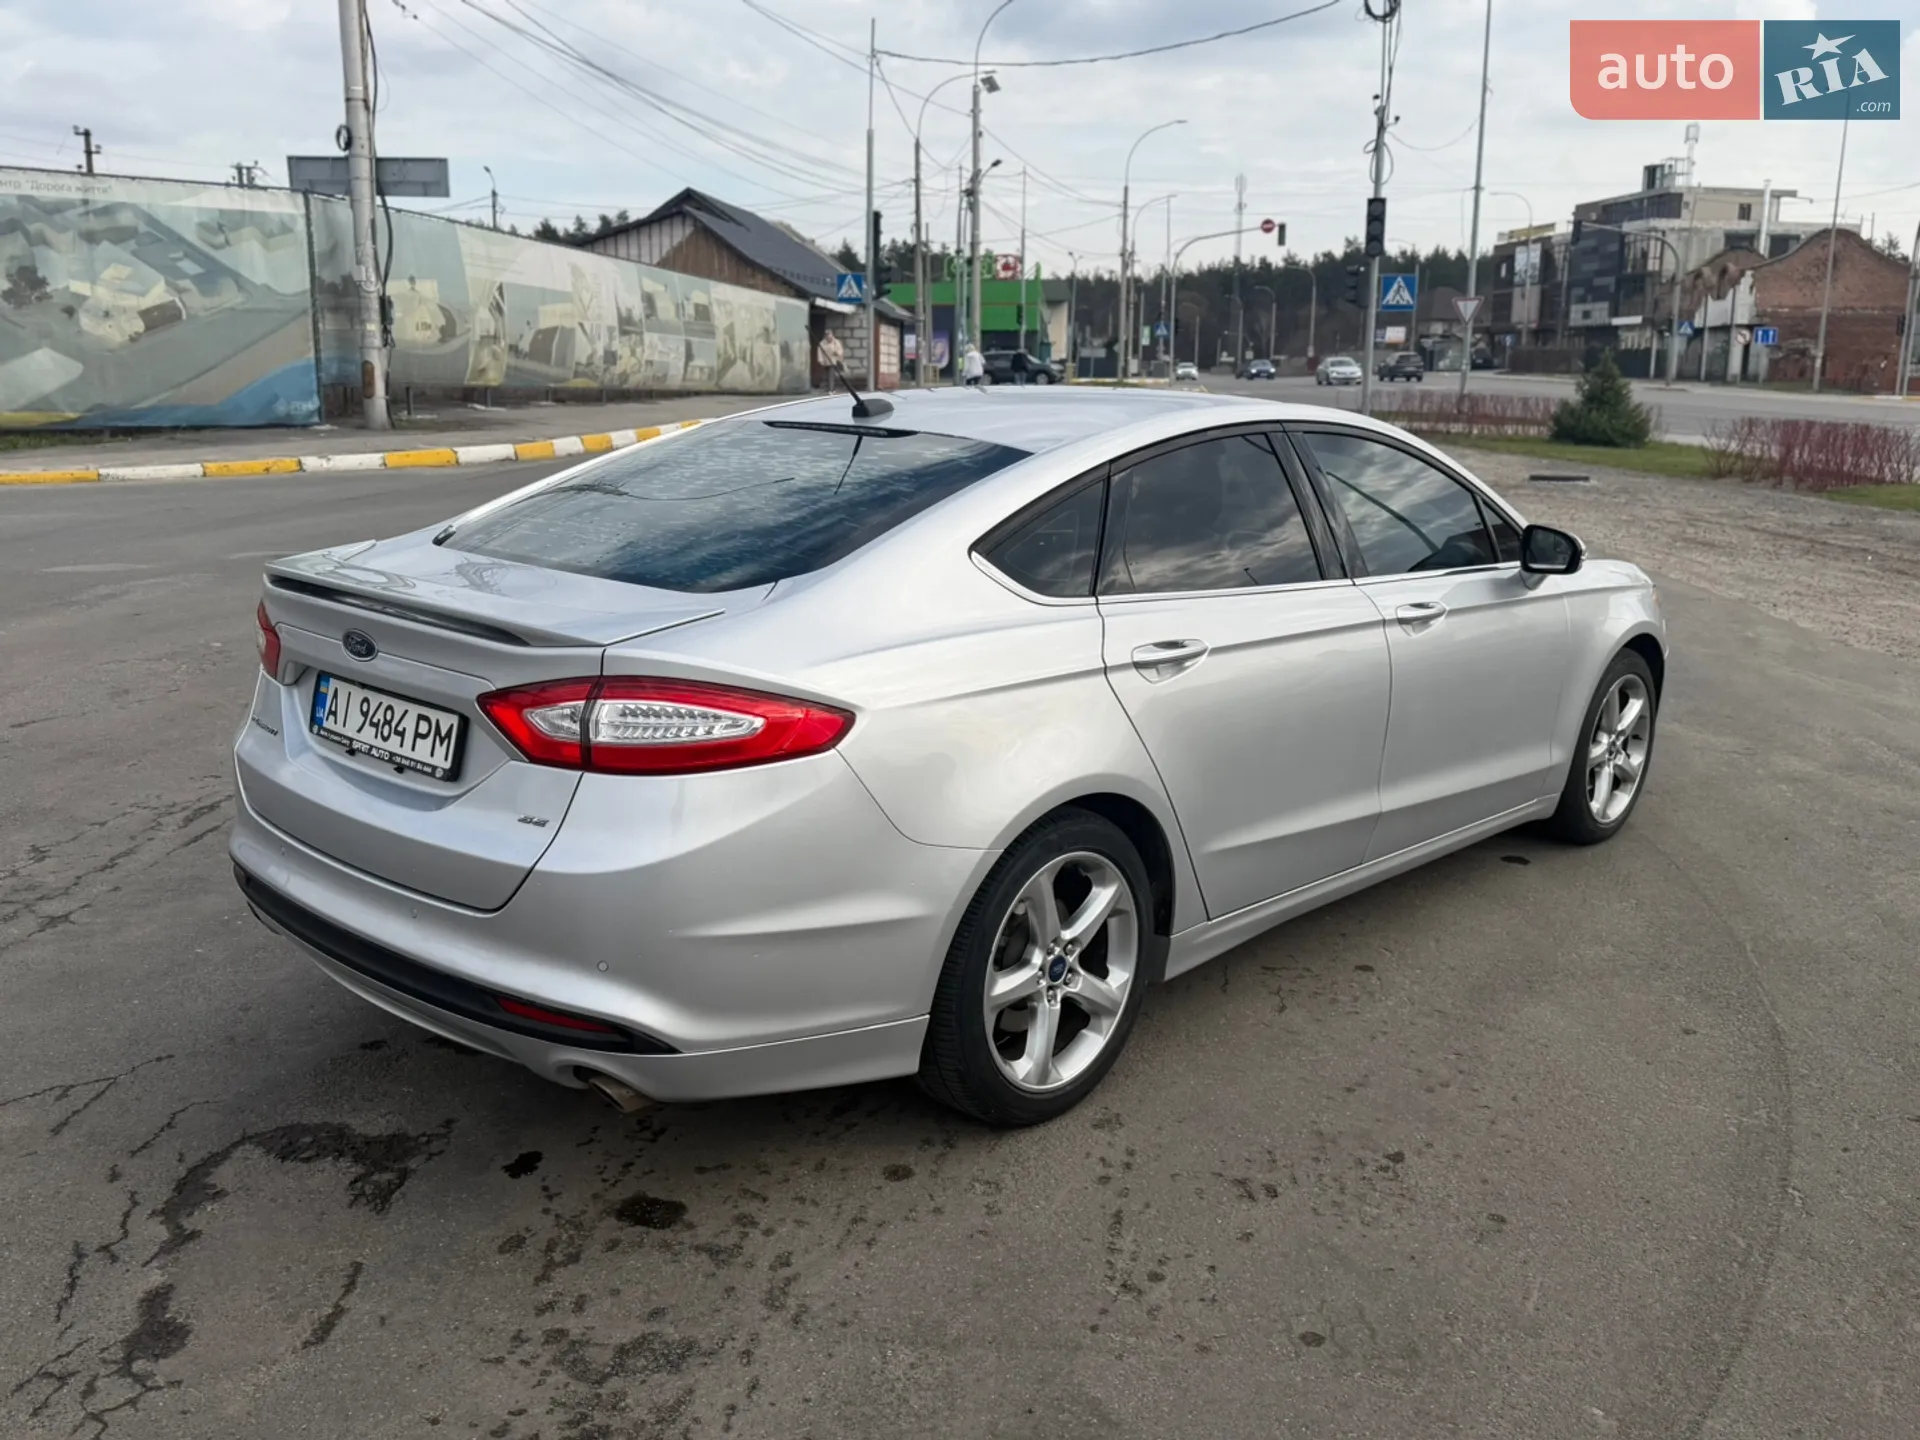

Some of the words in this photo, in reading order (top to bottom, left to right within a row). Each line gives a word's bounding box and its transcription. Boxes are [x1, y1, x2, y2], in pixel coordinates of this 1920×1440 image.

[325, 687, 352, 728] AI
[356, 696, 409, 748] 9484
[411, 713, 455, 762] PM
